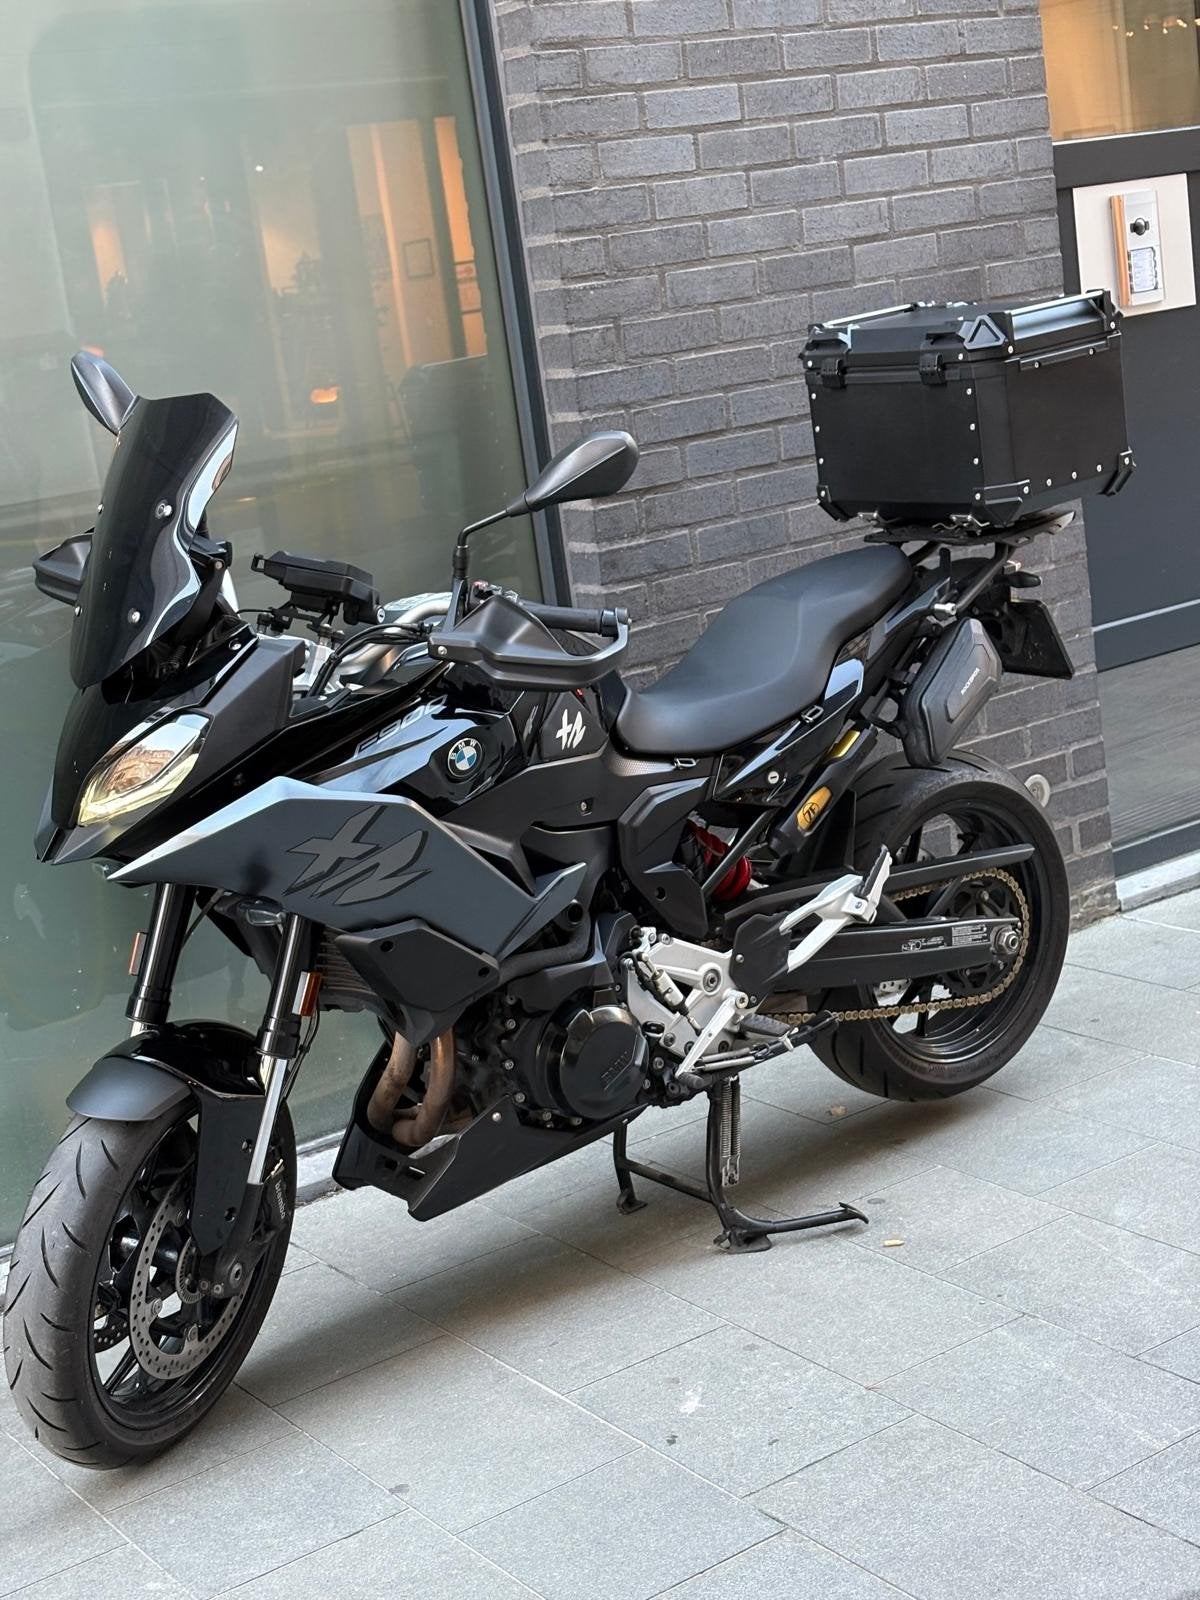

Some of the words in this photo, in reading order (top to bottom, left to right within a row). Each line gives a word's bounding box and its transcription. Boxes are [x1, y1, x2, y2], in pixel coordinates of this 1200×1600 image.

[354, 694, 448, 758] F900
[450, 739, 478, 760] BMW
[274, 1179, 287, 1220] brembo
